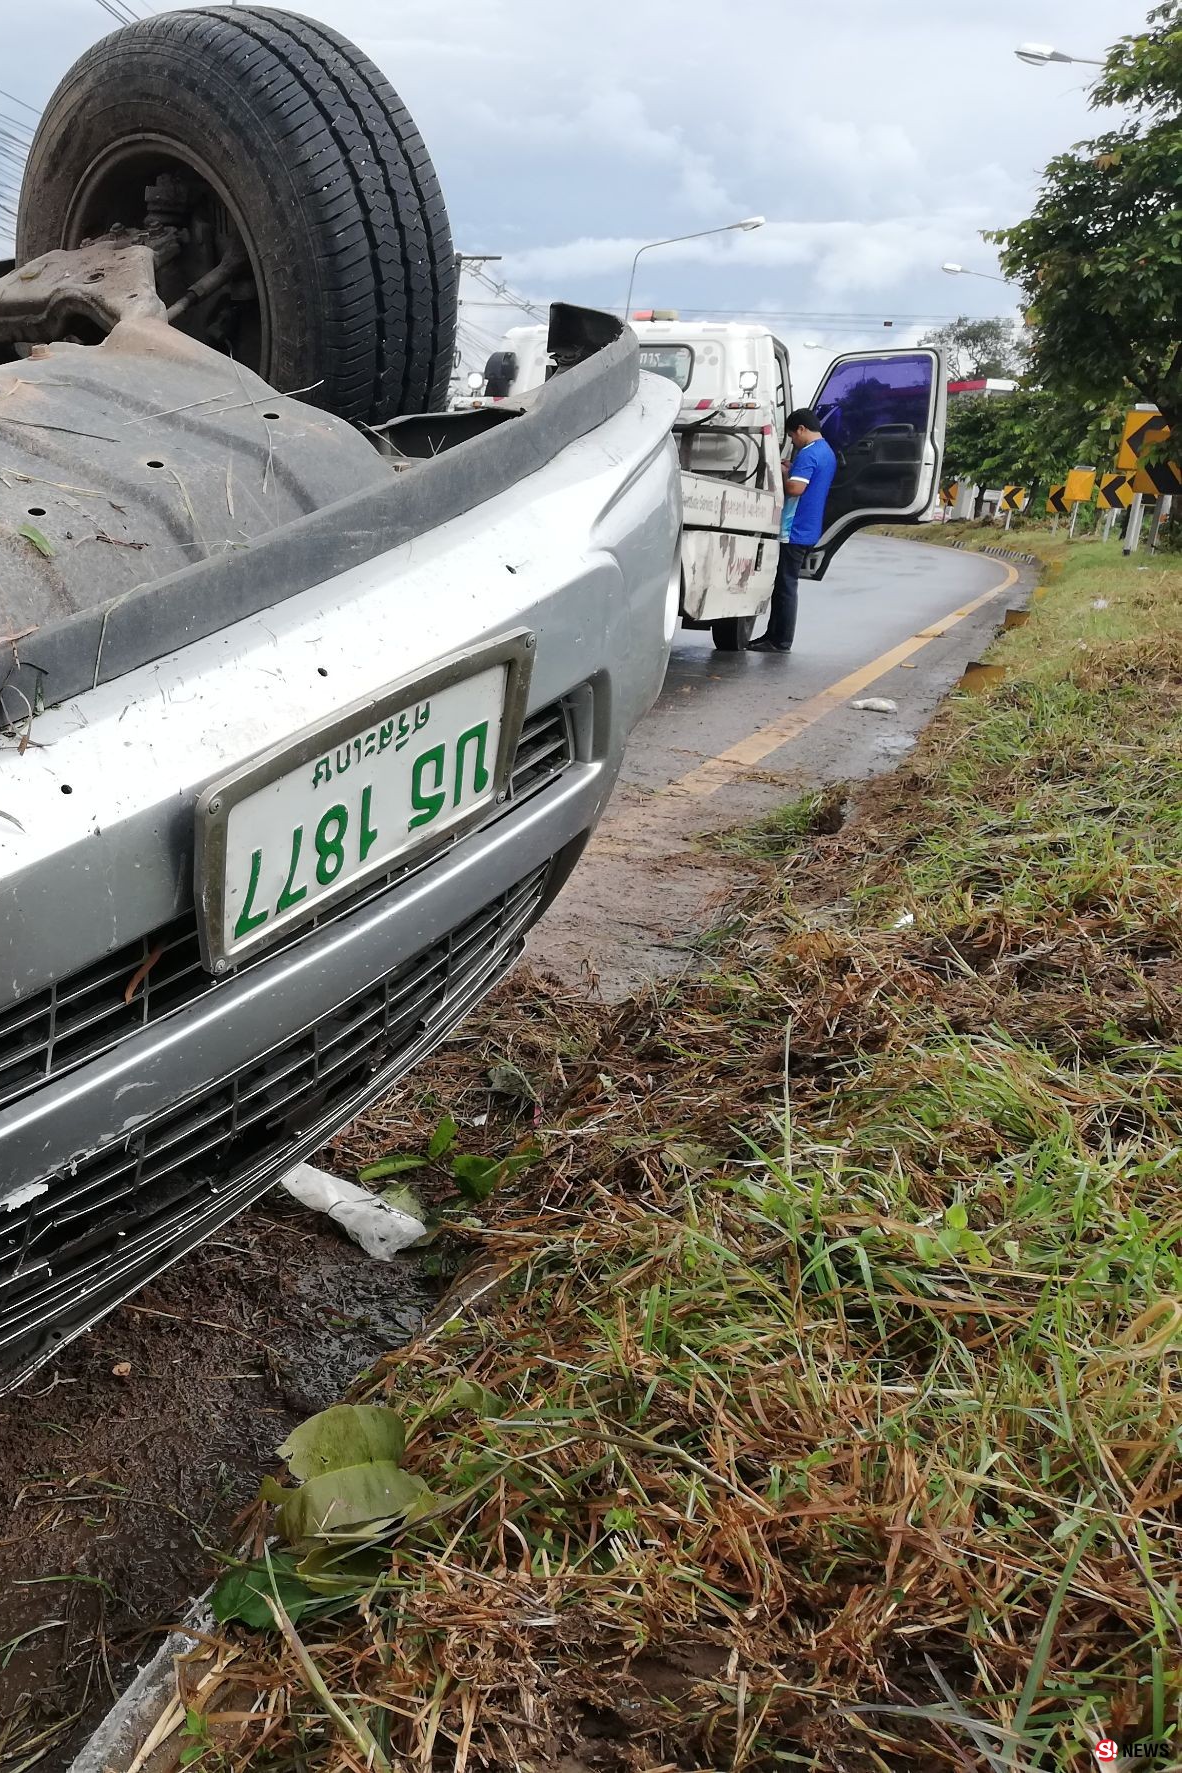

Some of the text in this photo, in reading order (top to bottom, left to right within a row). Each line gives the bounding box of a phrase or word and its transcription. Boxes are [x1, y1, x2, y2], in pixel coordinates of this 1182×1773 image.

[312, 702, 431, 788] ศรีสะเกษ
[234, 720, 490, 940] บธ 1877
